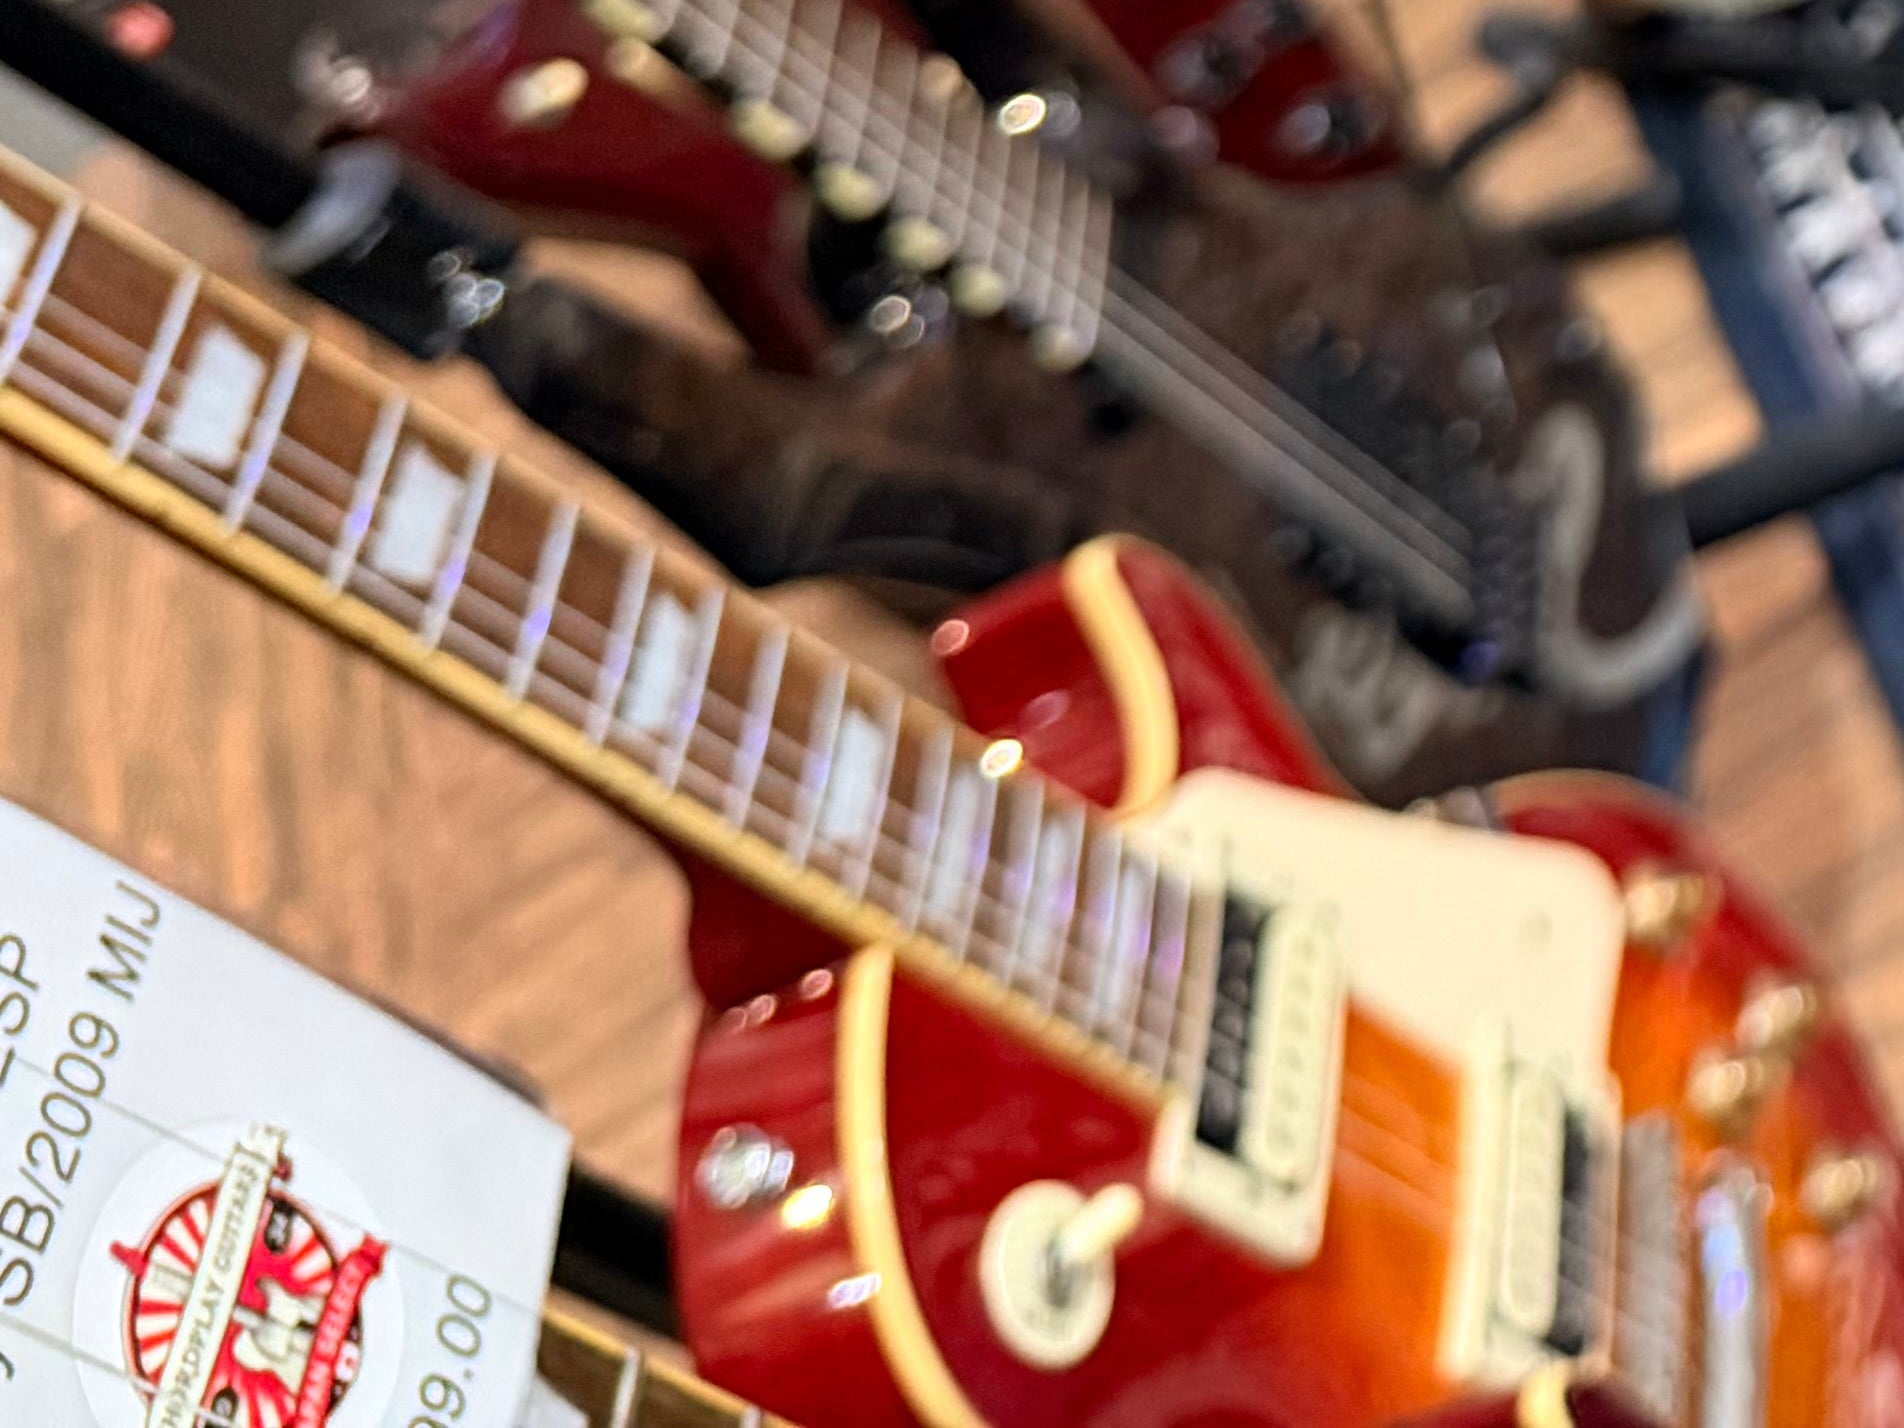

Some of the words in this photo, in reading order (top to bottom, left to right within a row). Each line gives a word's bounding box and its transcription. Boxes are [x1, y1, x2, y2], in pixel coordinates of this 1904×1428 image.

[0, 931, 40, 1087] SP
[86, 879, 161, 1003] MIJ
[161, 1279, 226, 1428] HORDPLAY
[407, 1274, 492, 1428] 9.00
